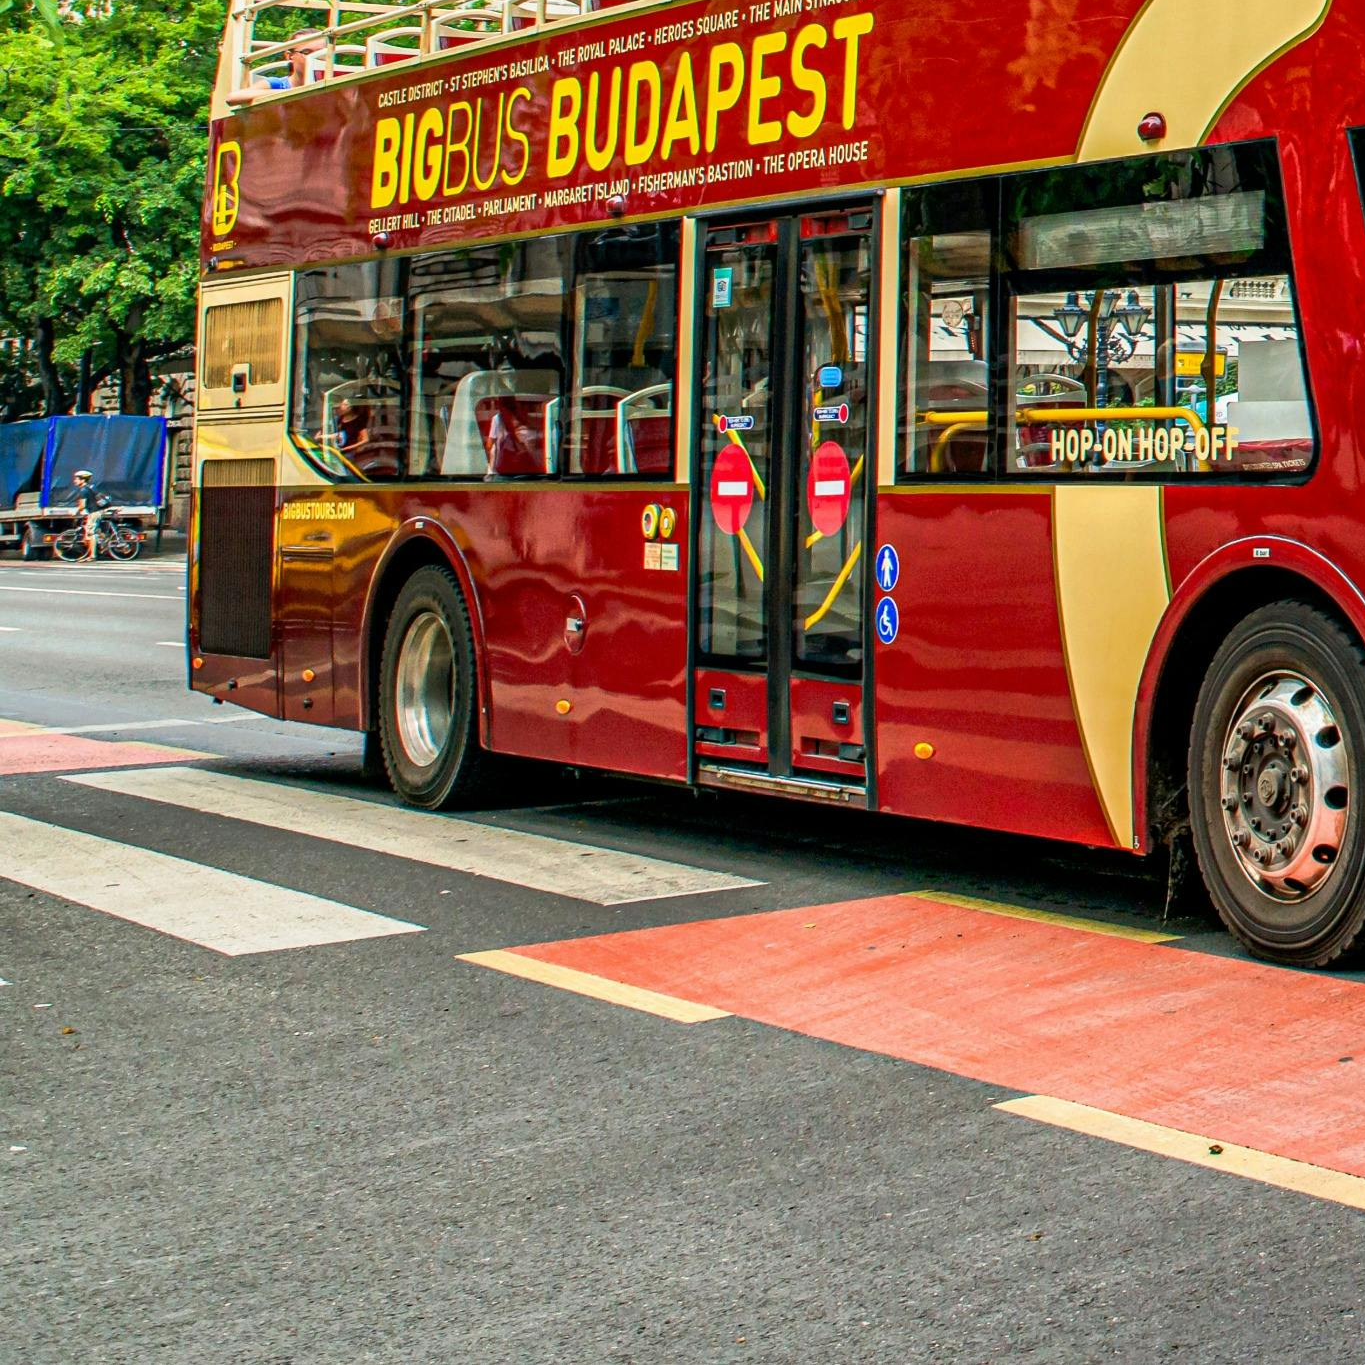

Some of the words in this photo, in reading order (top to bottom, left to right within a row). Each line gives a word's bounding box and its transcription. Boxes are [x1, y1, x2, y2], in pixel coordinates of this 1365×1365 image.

[378, 88, 407, 108] CASTLE
[408, 80, 444, 102] DISTRICT
[450, 76, 460, 92] ST
[462, 65, 508, 89] STEPHEN'S
[509, 55, 549, 79] BASILICA
[558, 48, 575, 67] THE
[577, 41, 606, 63] ROYAL
[608, 31, 646, 56] PALACE
[654, 20, 694, 45] HEROES
[696, 9, 739, 36] SQUARE
[749, 2, 771, 23] THE
[546, 12, 874, 178] BUDAPEST
[368, 215, 401, 235] GELLERT
[402, 212, 420, 229] HILL
[426, 209, 441, 226] THE
[443, 204, 476, 223] CITADEL
[482, 193, 537, 217] PARLIAMENT
[544, 184, 594, 208] MARGARET
[595, 179, 630, 200] ISLAND
[638, 167, 705, 194] FISHERMAN'S
[707, 159, 753, 183] BASTION
[763, 154, 785, 175] THE
[787, 148, 826, 171] OPERA
[829, 140, 869, 165] HOUSE
[1051, 428, 1132, 462] HOP-ON
[1139, 426, 1240, 462] HOP-OFF
[1282, 458, 1306, 468] TICKETS
[283, 502, 355, 520] BIGBUSTOURS.COM
